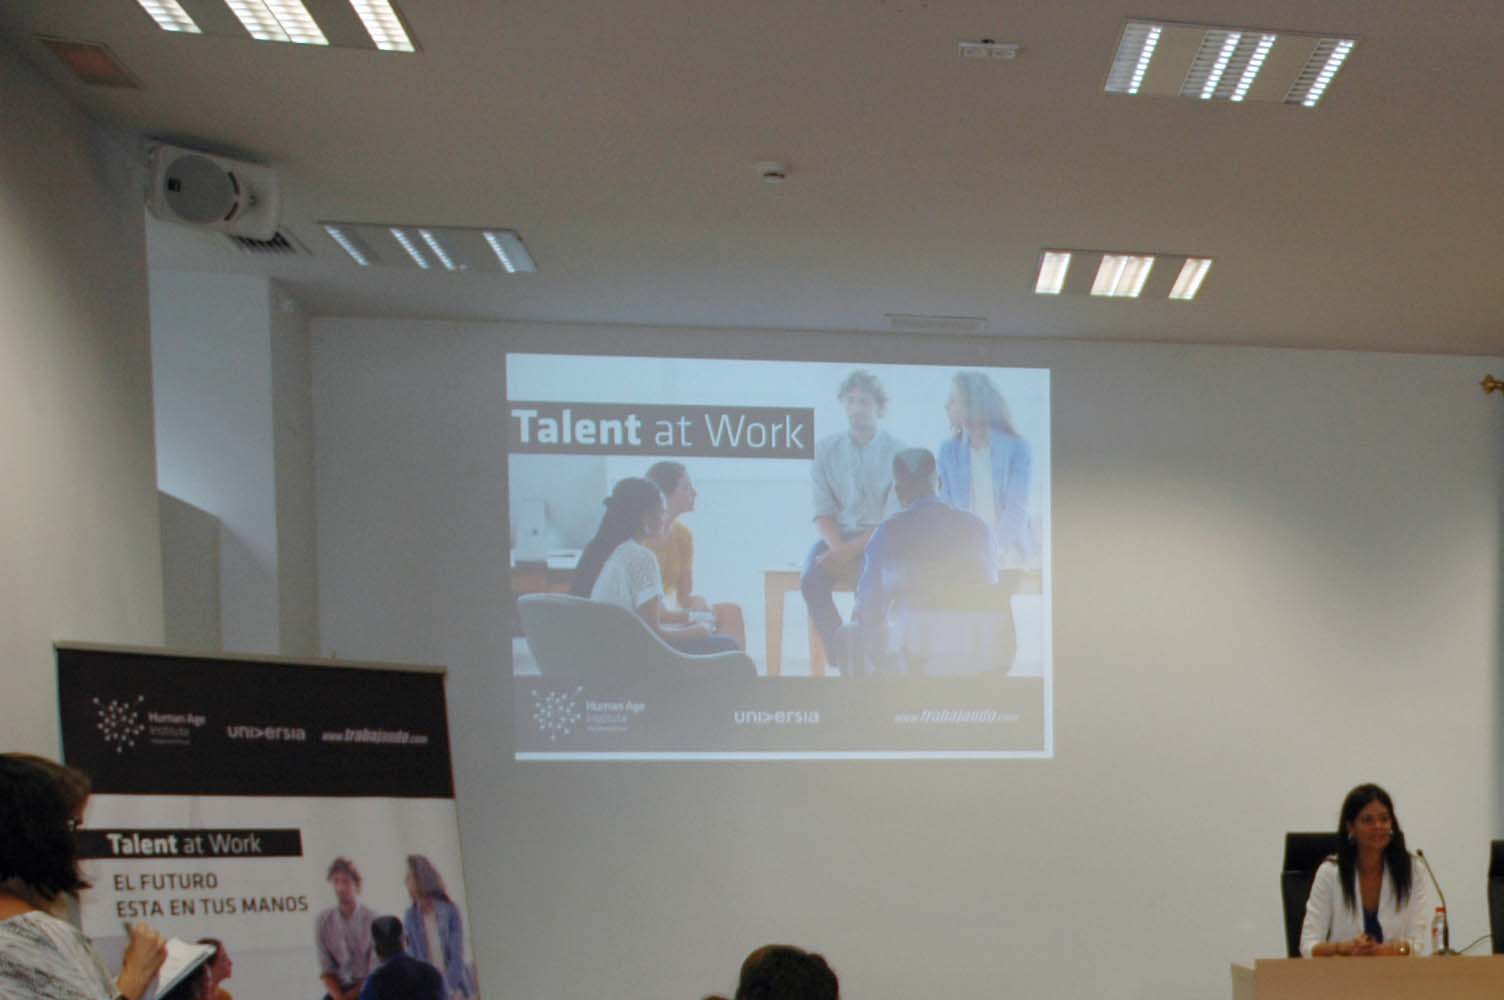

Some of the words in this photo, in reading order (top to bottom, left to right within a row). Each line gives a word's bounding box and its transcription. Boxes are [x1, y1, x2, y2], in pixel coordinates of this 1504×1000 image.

[512, 408, 641, 447] Talent
[654, 415, 692, 448] at
[705, 413, 804, 450] Work
[106, 833, 179, 854] Talent
[183, 837, 204, 854] at
[208, 833, 262, 853] Work
[113, 873, 134, 891] EL
[140, 872, 218, 890] FUTURO
[116, 899, 164, 918] ESTA
[170, 898, 195, 916] EN
[200, 897, 237, 915] TUS
[242, 895, 309, 913] MANOS
